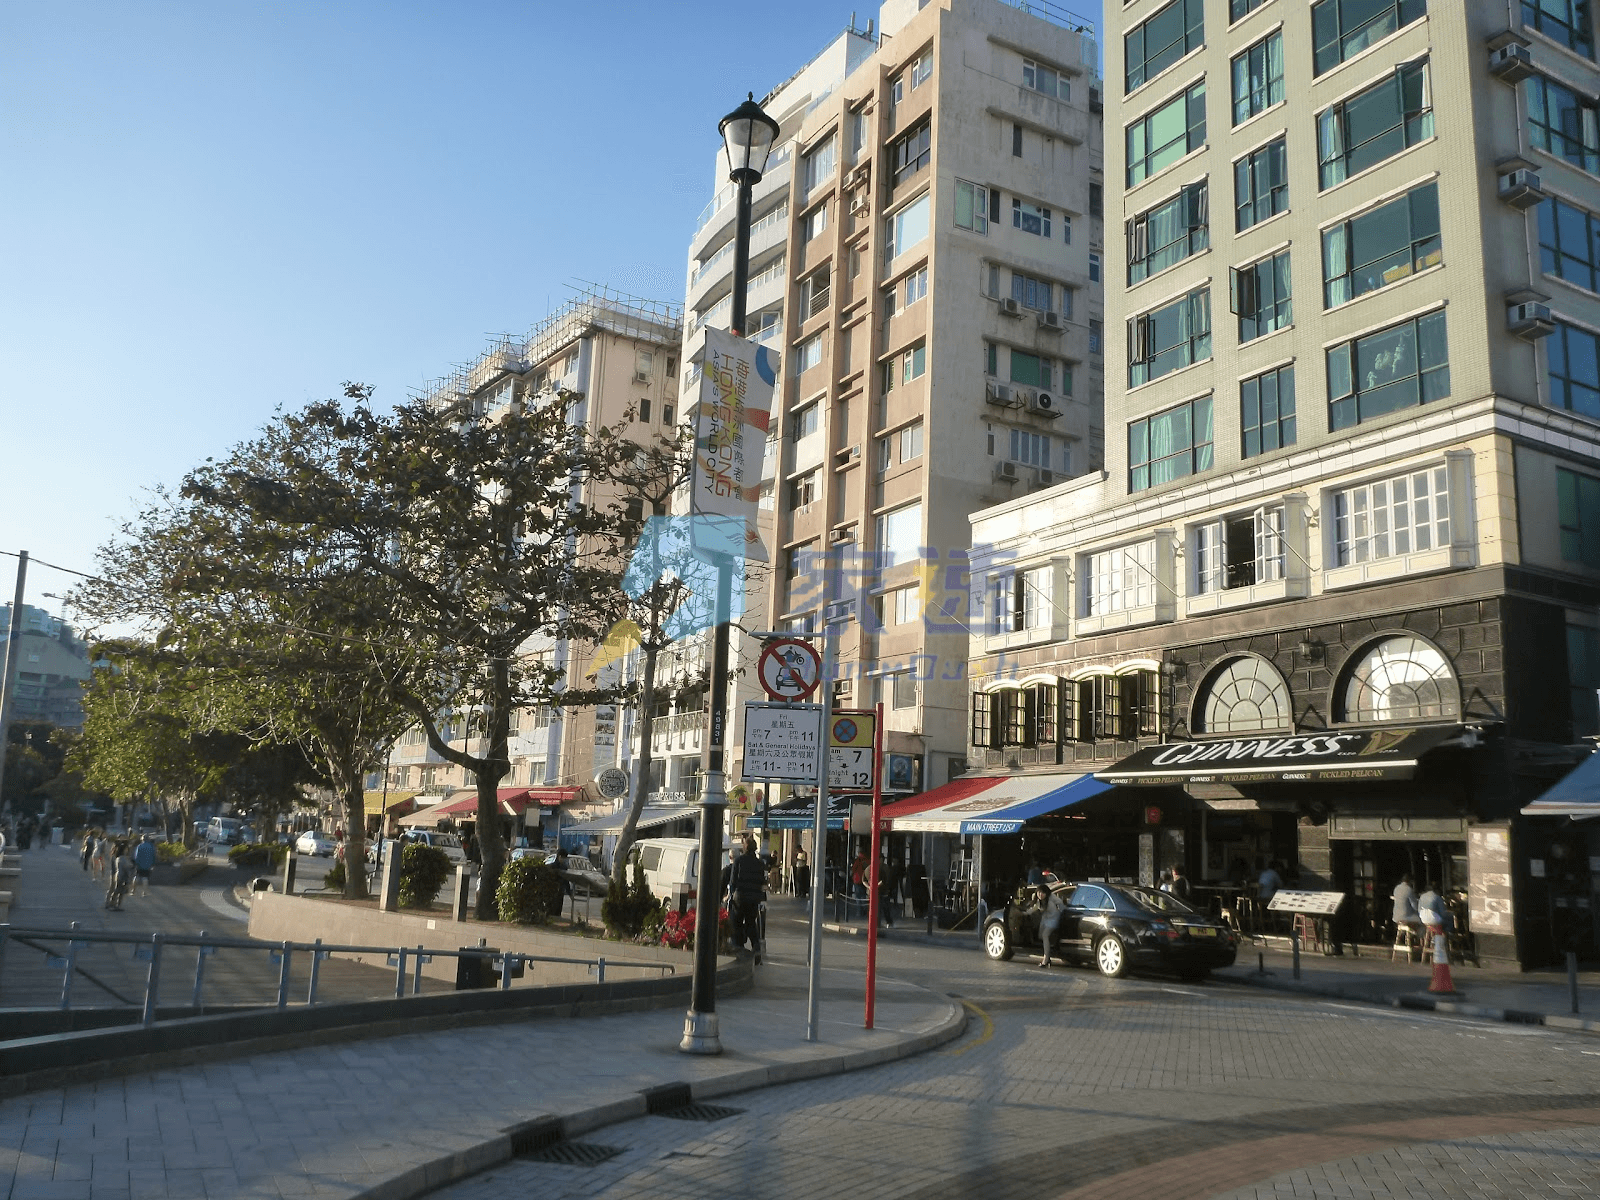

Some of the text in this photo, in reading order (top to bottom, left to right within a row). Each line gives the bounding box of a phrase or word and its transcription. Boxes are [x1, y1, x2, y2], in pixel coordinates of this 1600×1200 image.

[704, 349, 720, 494] ASIA'S WORLD CITY
[715, 352, 735, 498] HONG KONG
[771, 721, 795, 729] 星期五
[764, 730, 771, 740] 7
[801, 731, 814, 742] 11
[1151, 734, 1351, 766] GUINNESS
[853, 750, 862, 763] 7
[763, 761, 775, 771] 11
[800, 763, 812, 773] 11
[852, 772, 869, 785] 12
[1249, 773, 1276, 781] PELICAN
[1319, 769, 1384, 779] PICKLED PELICAN
[966, 823, 981, 832] MAIN
[982, 823, 1002, 832] STREET
